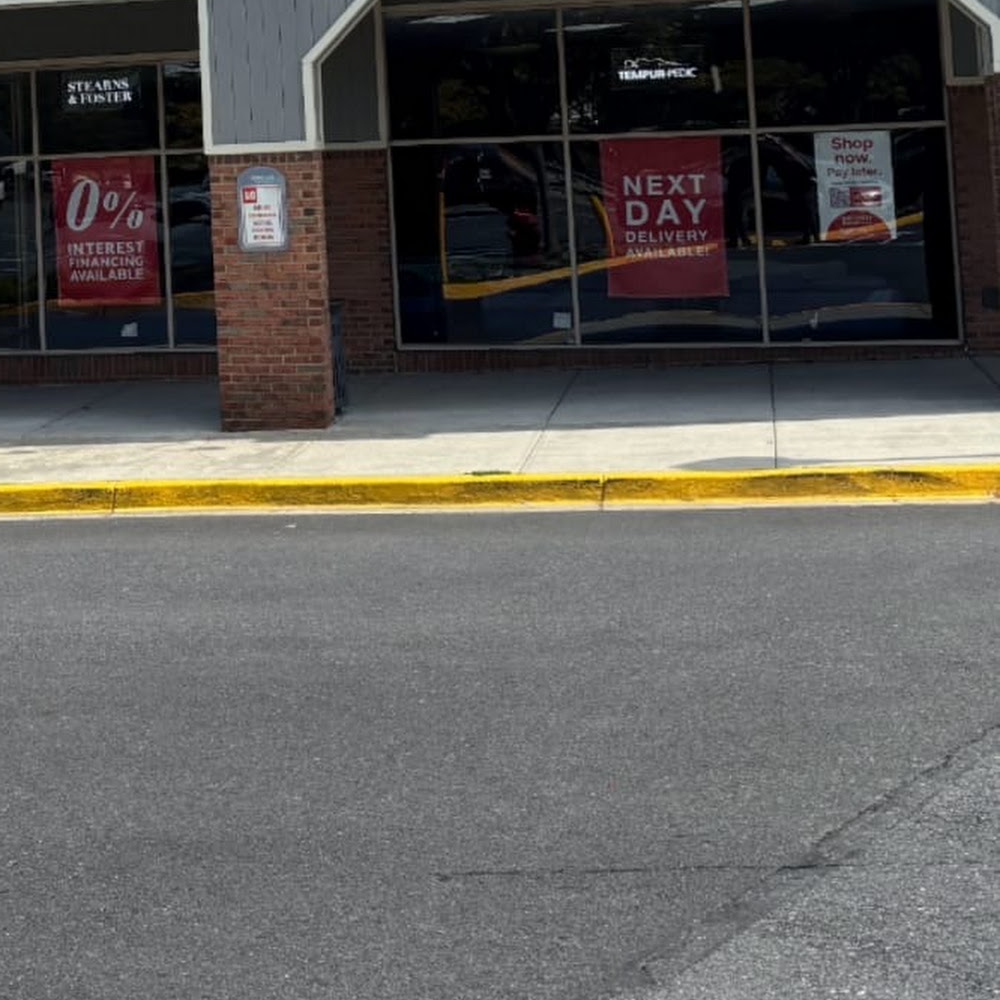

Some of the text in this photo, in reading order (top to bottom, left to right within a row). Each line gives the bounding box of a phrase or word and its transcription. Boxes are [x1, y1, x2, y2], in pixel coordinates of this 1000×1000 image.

[67, 77, 129, 93] STEARNS
[68, 91, 132, 104] & FOSTER
[831, 137, 873, 151] Shop
[835, 153, 872, 164] now.
[827, 167, 849, 179] Pay
[623, 174, 706, 196] NEXT
[66, 177, 144, 232] 0%
[625, 199, 707, 226] DAY
[626, 230, 708, 243] DELIVERY
[67, 240, 145, 256] INTEREST
[627, 246, 709, 259] AVAILABLE!
[68, 256, 144, 268] FINANCING
[70, 267, 145, 283] AVAILABLE
